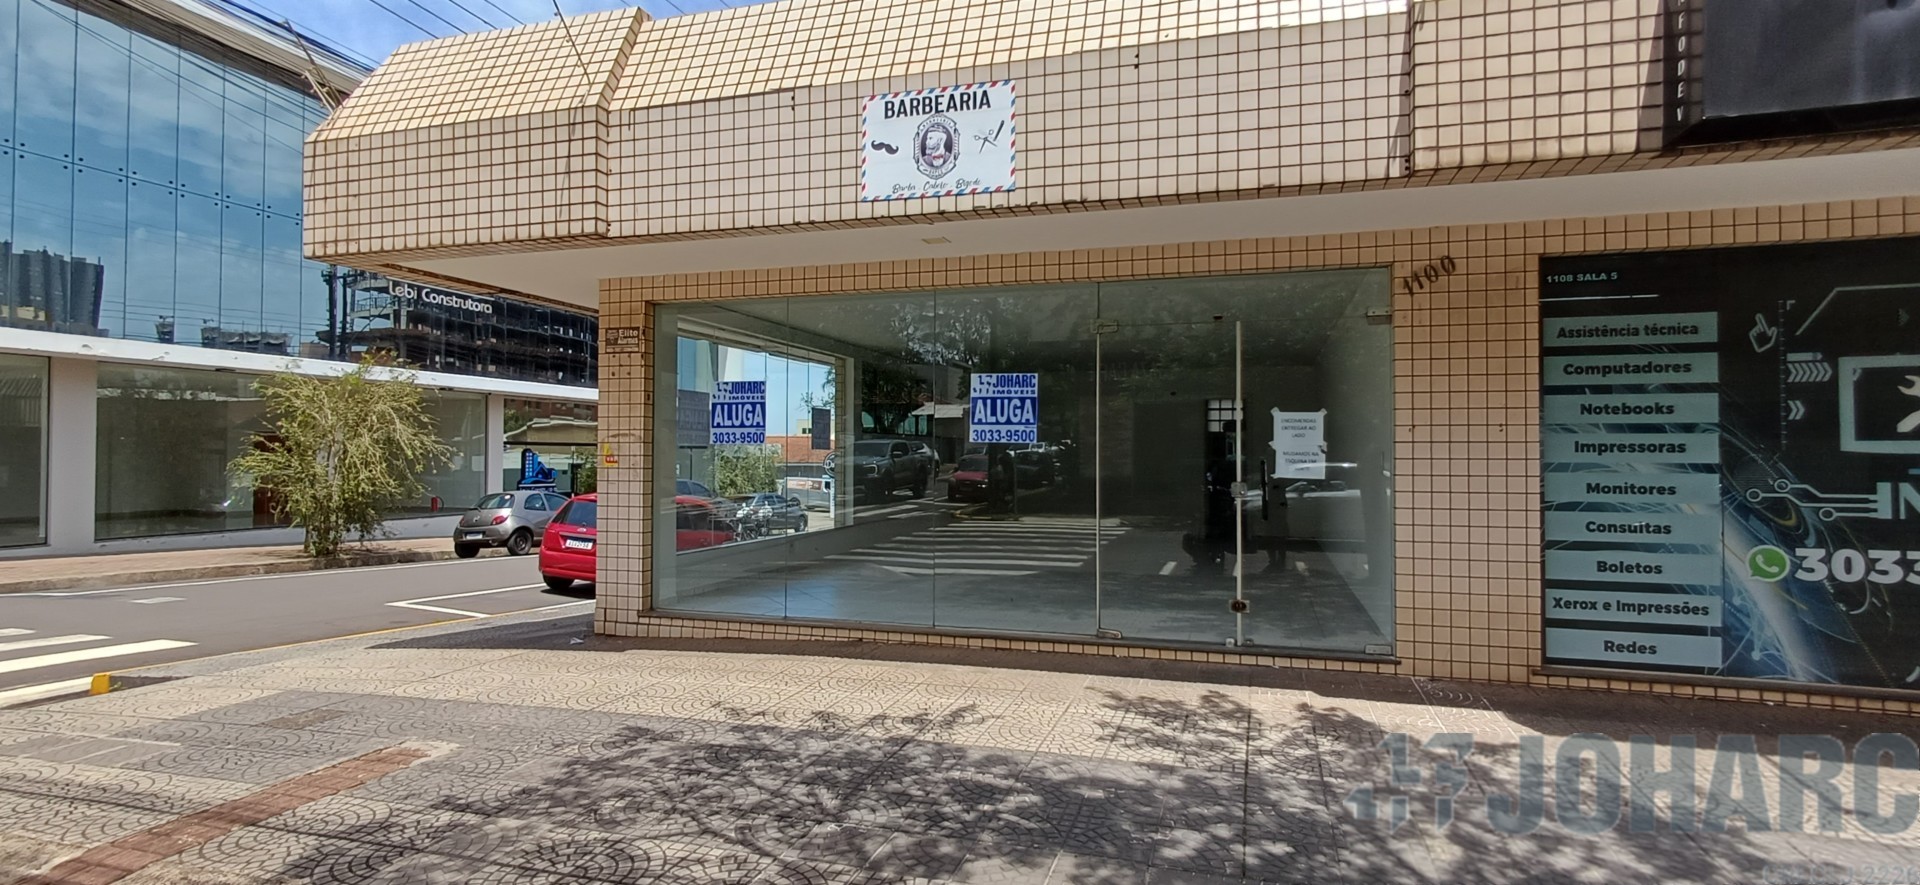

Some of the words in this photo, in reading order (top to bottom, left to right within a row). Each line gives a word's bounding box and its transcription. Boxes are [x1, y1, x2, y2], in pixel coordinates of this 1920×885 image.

[884, 90, 991, 119] BARBEARIA
[1403, 255, 1456, 296] 1100
[1547, 275, 1573, 283] 1108
[1577, 273, 1607, 281] SALA
[1610, 272, 1618, 280] 5
[389, 281, 417, 299] Lebi
[422, 288, 492, 314] Construtora
[1556, 324, 1640, 339] Assistência
[1644, 322, 1699, 336] técnica
[1563, 361, 1692, 378] Computadores
[729, 381, 765, 395] JOHARC
[993, 374, 1036, 388] JOHARC
[713, 403, 764, 427] ALUGA
[973, 398, 1034, 423] ALUGA
[1580, 403, 1675, 415] Notebooks
[712, 431, 765, 444] 3033-9500
[972, 429, 1035, 442] 3033-9500
[1574, 441, 1687, 456] Impressoras
[1586, 482, 1677, 496] Monitores
[1596, 560, 1663, 575] Boletos
[1552, 597, 1598, 611] Xerox
[1602, 602, 1612, 611] e
[1616, 600, 1709, 616] Impressões
[1603, 640, 1657, 655] Redes
